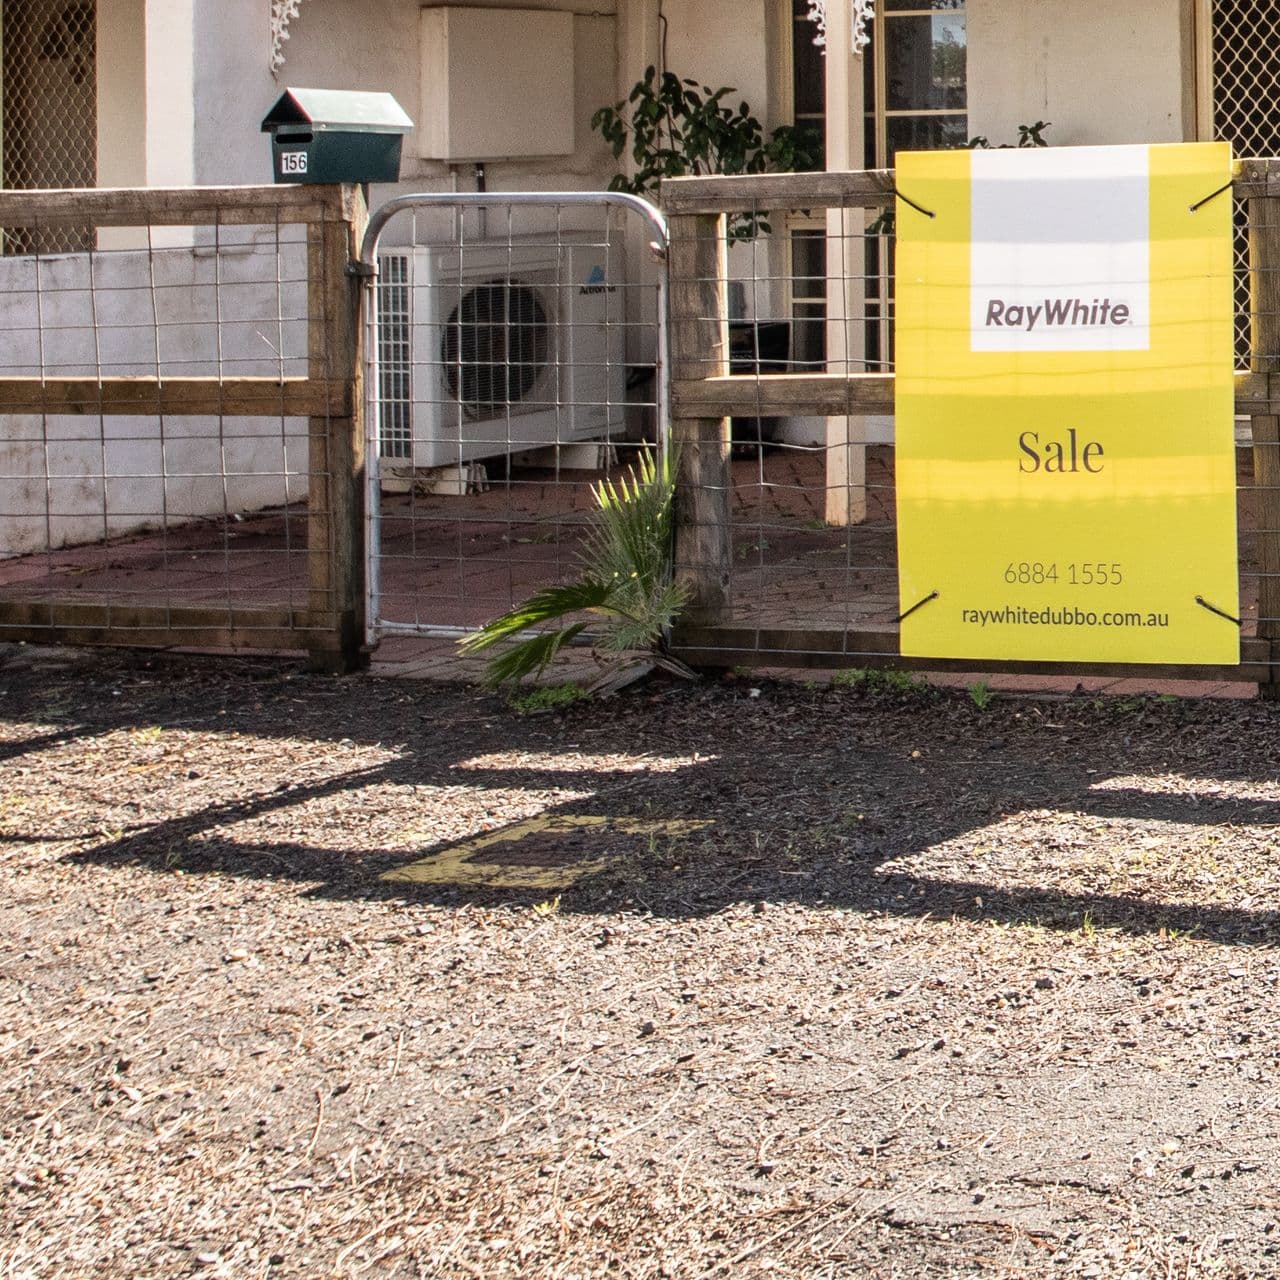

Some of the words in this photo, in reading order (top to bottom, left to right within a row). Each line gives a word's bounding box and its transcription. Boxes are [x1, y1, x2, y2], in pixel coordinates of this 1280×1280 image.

[283, 154, 307, 170] 156
[1018, 427, 1105, 474] Sale
[1004, 562, 1060, 585] 6884
[1068, 563, 1123, 586] 1555
[961, 605, 1169, 627] raywhitedubbo.com.au
